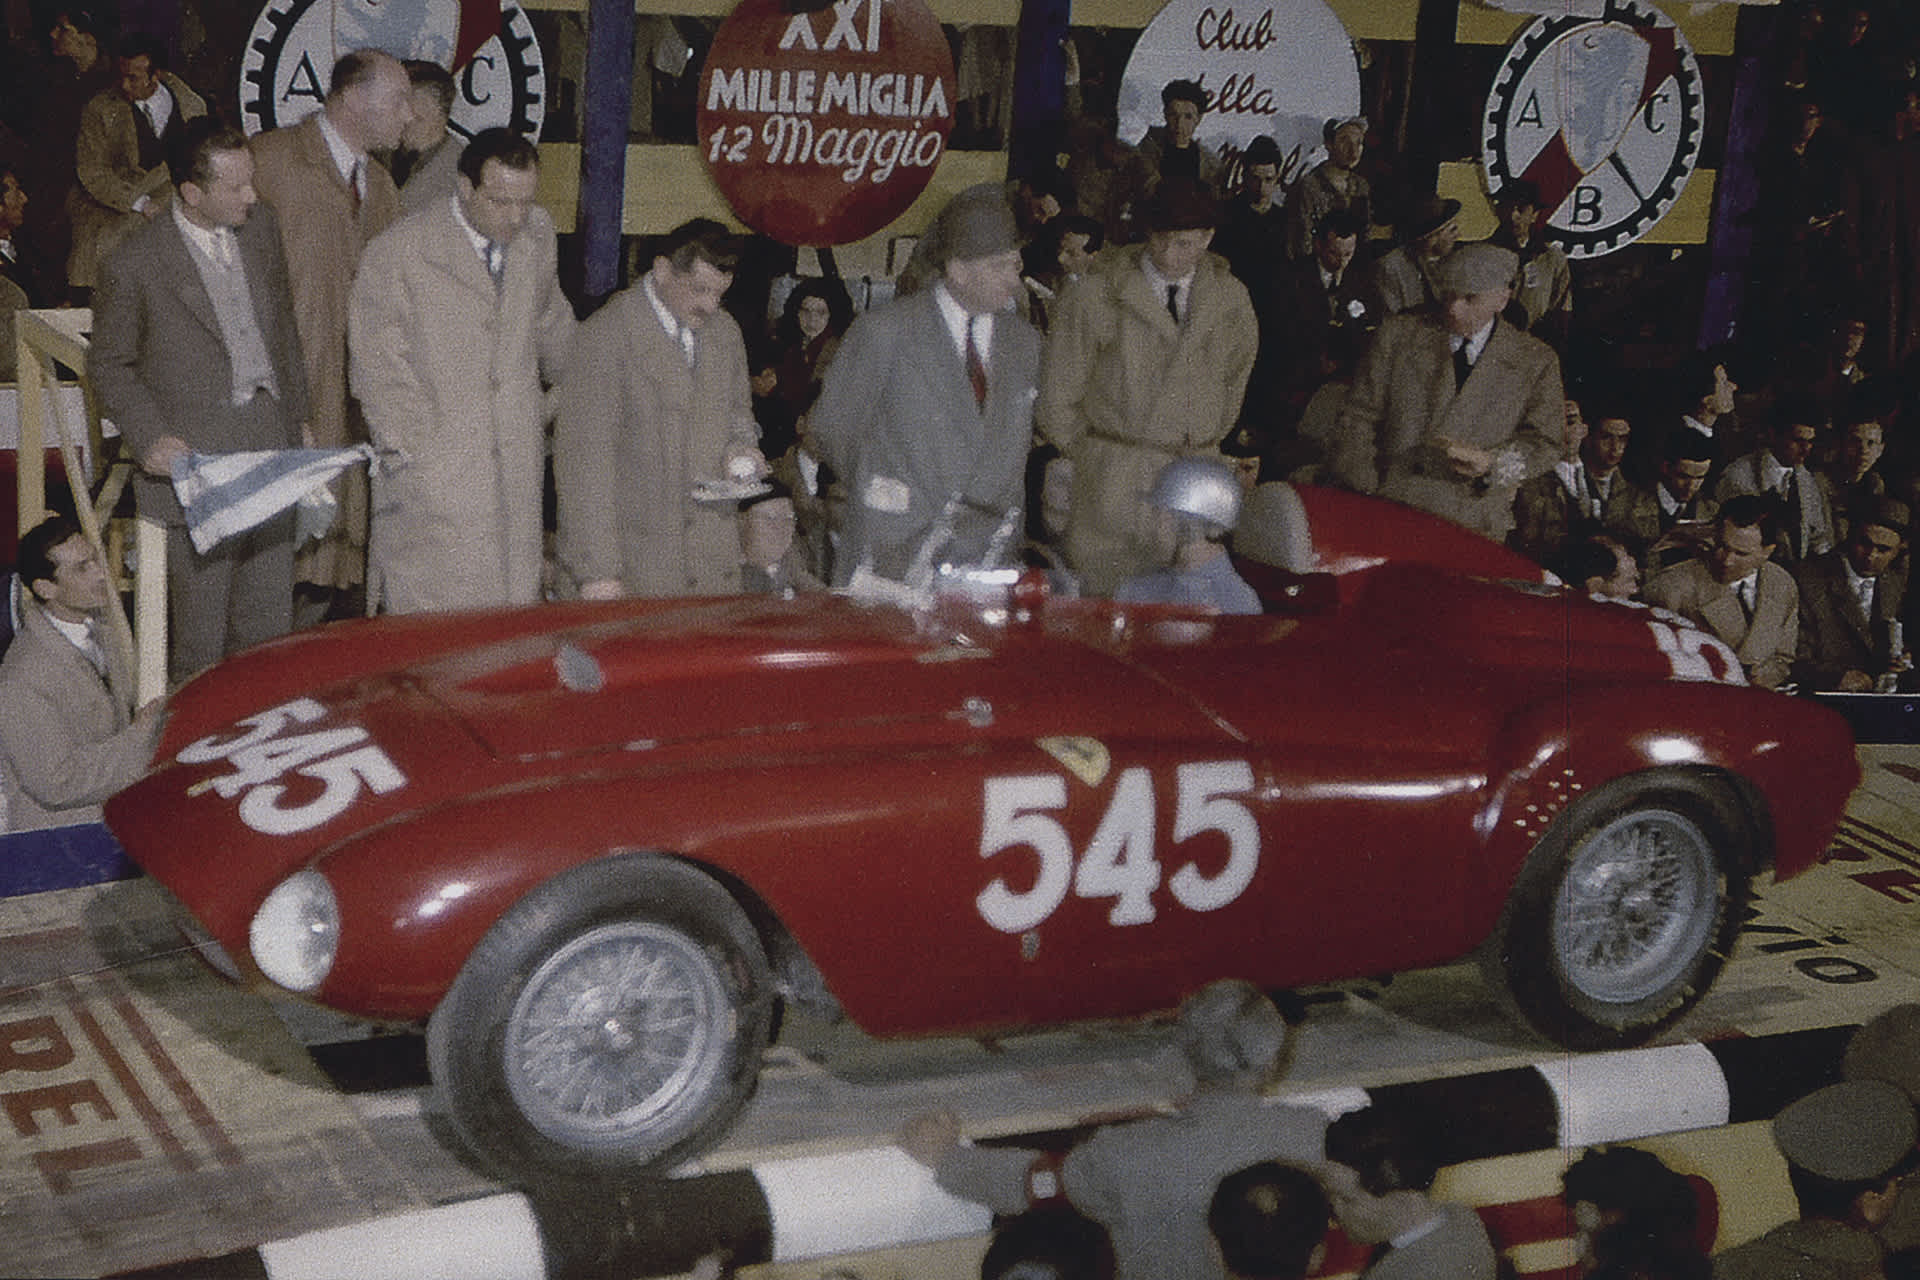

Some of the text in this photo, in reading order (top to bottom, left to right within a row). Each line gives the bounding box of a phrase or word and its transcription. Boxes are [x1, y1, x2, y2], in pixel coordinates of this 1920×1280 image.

[1196, 8, 1277, 50] Club
[283, 50, 327, 102] A
[461, 55, 495, 106] C
[706, 67, 949, 118] MILLE MIGLIA
[1199, 73, 1278, 114] ella
[1515, 89, 1543, 129] A
[1644, 93, 1669, 134] C
[762, 114, 942, 184] Maggio
[1569, 185, 1602, 226] B
[176, 697, 410, 836] 545
[976, 760, 1261, 933] 545
